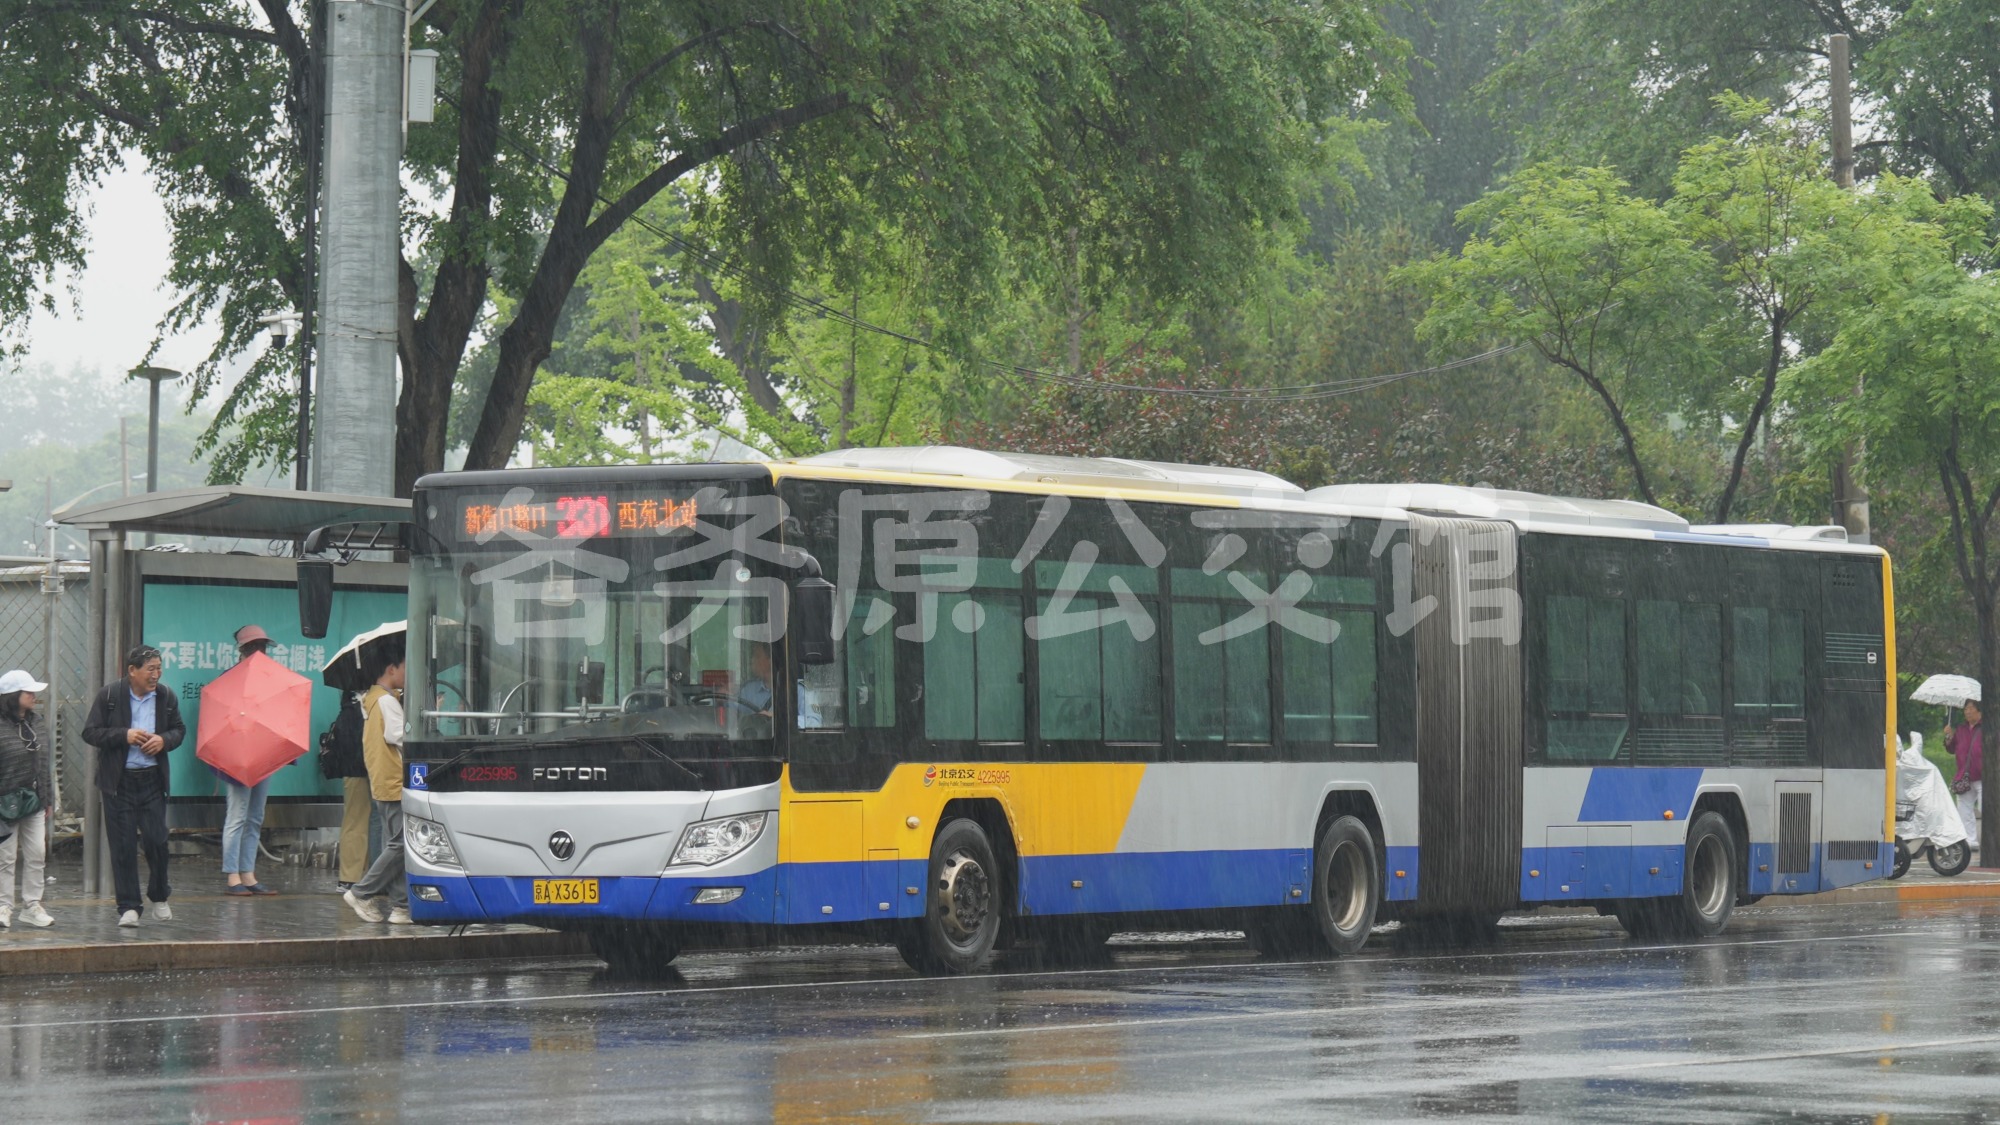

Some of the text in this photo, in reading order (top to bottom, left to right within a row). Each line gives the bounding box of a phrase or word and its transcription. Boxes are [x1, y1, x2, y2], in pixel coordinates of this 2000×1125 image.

[555, 495, 609, 537] 331
[617, 498, 697, 529] 西苑北站
[159, 641, 326, 673] 不要让你命搁浅
[460, 766, 517, 781] 4225995
[532, 767, 608, 781] FOTON
[939, 769, 975, 779] 北京公交
[977, 770, 1011, 784] 4225995
